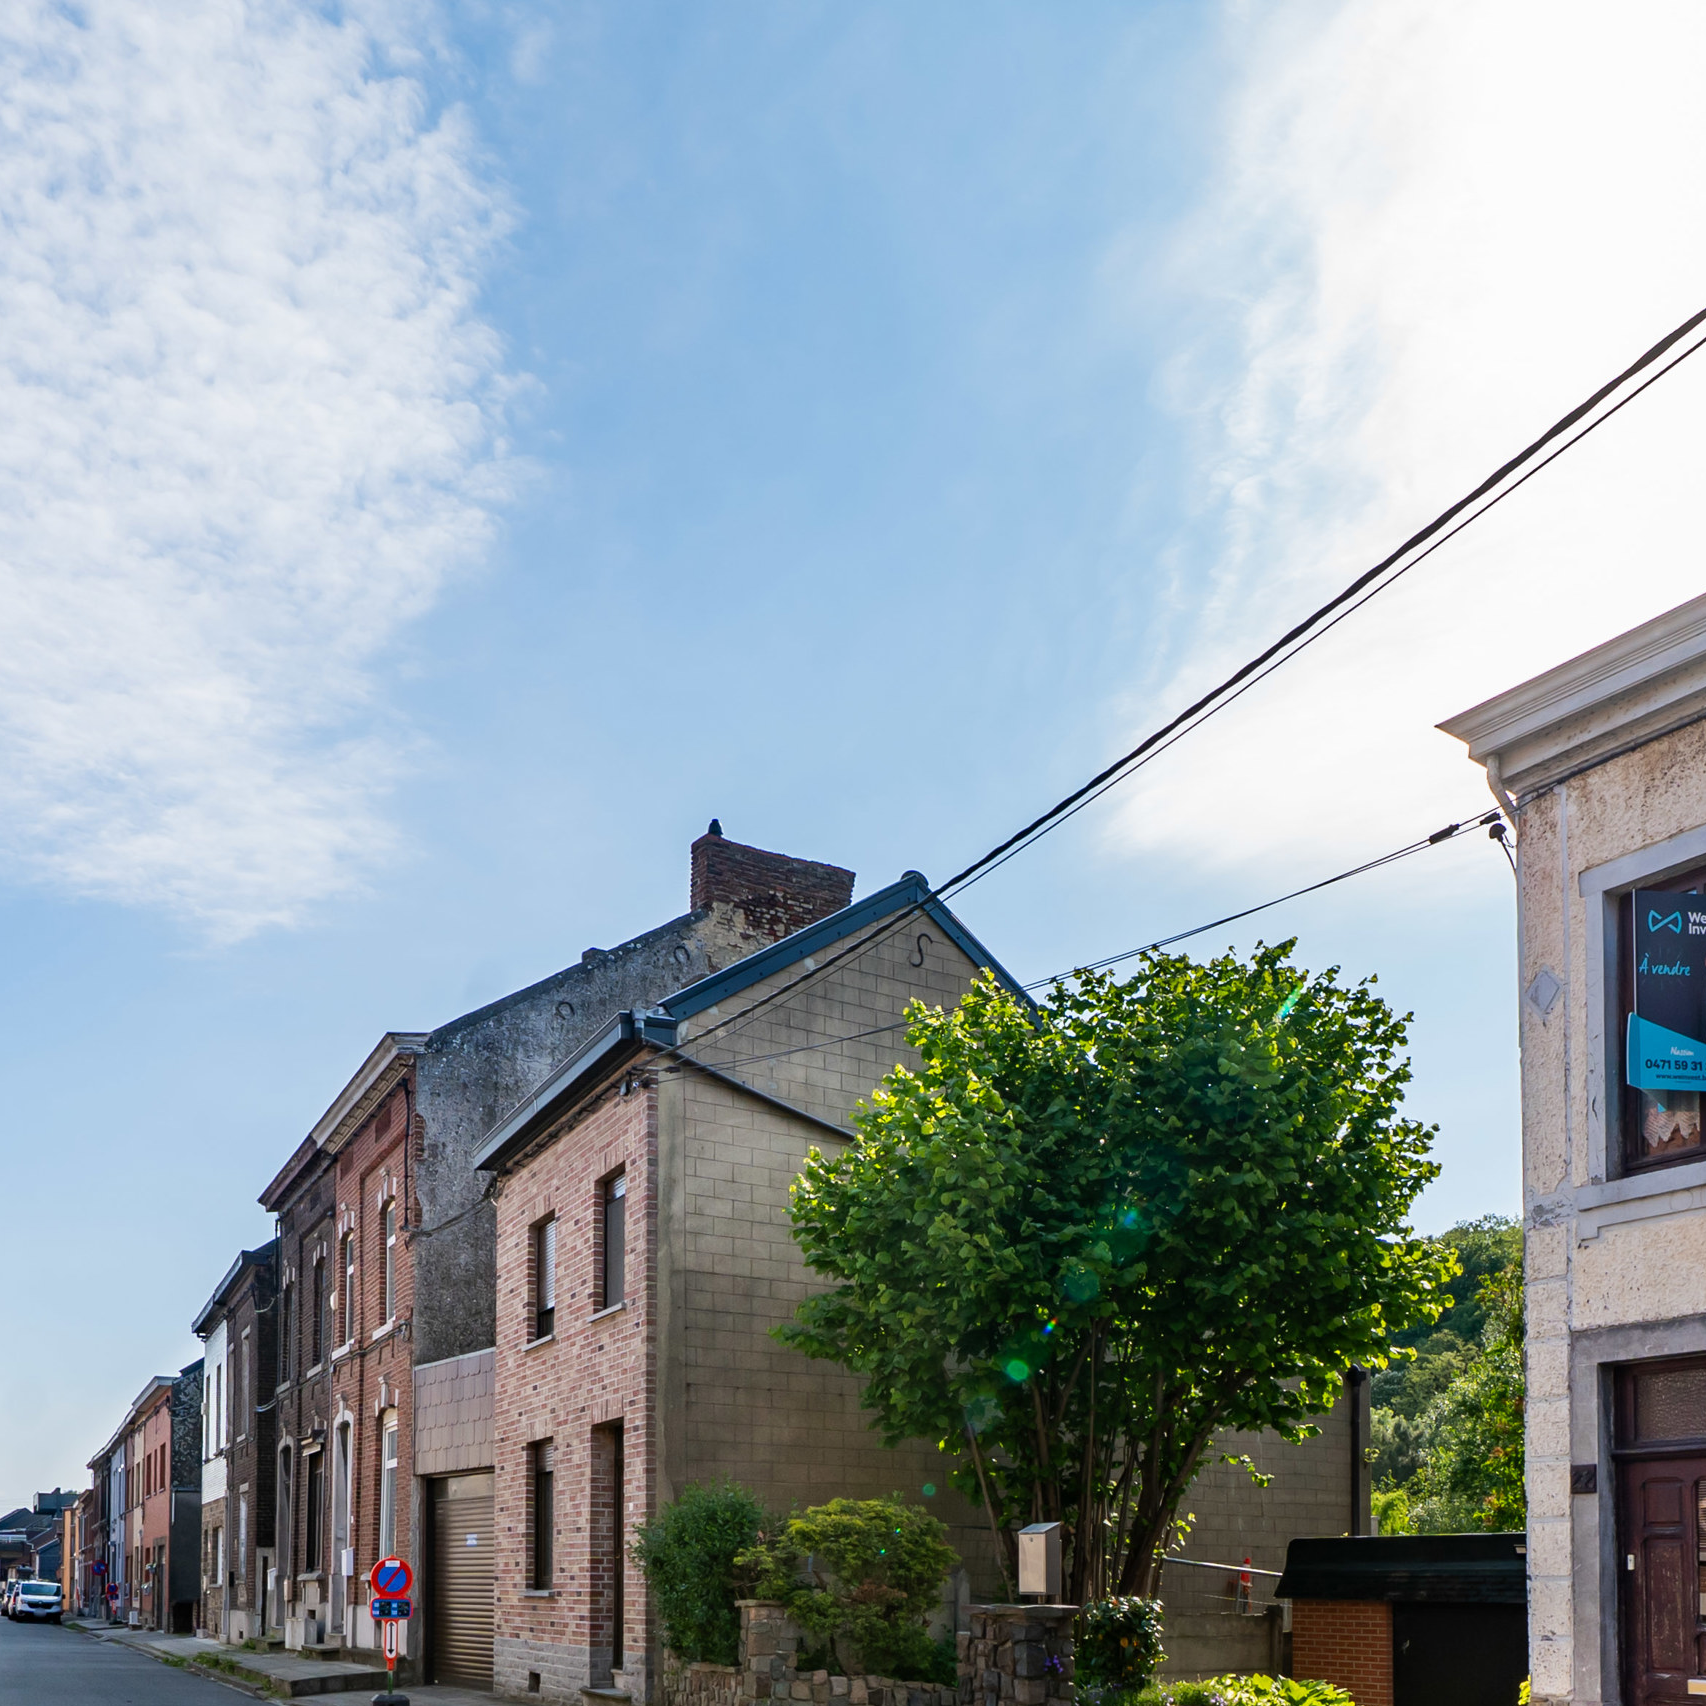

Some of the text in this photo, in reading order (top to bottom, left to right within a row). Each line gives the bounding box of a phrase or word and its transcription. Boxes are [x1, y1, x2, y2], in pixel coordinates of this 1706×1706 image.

[1639, 952, 1691, 976] À vendre
[1645, 1059, 1671, 1070] 0471
[1674, 1060, 1688, 1071] 59
[1691, 1061, 1703, 1071] 31
